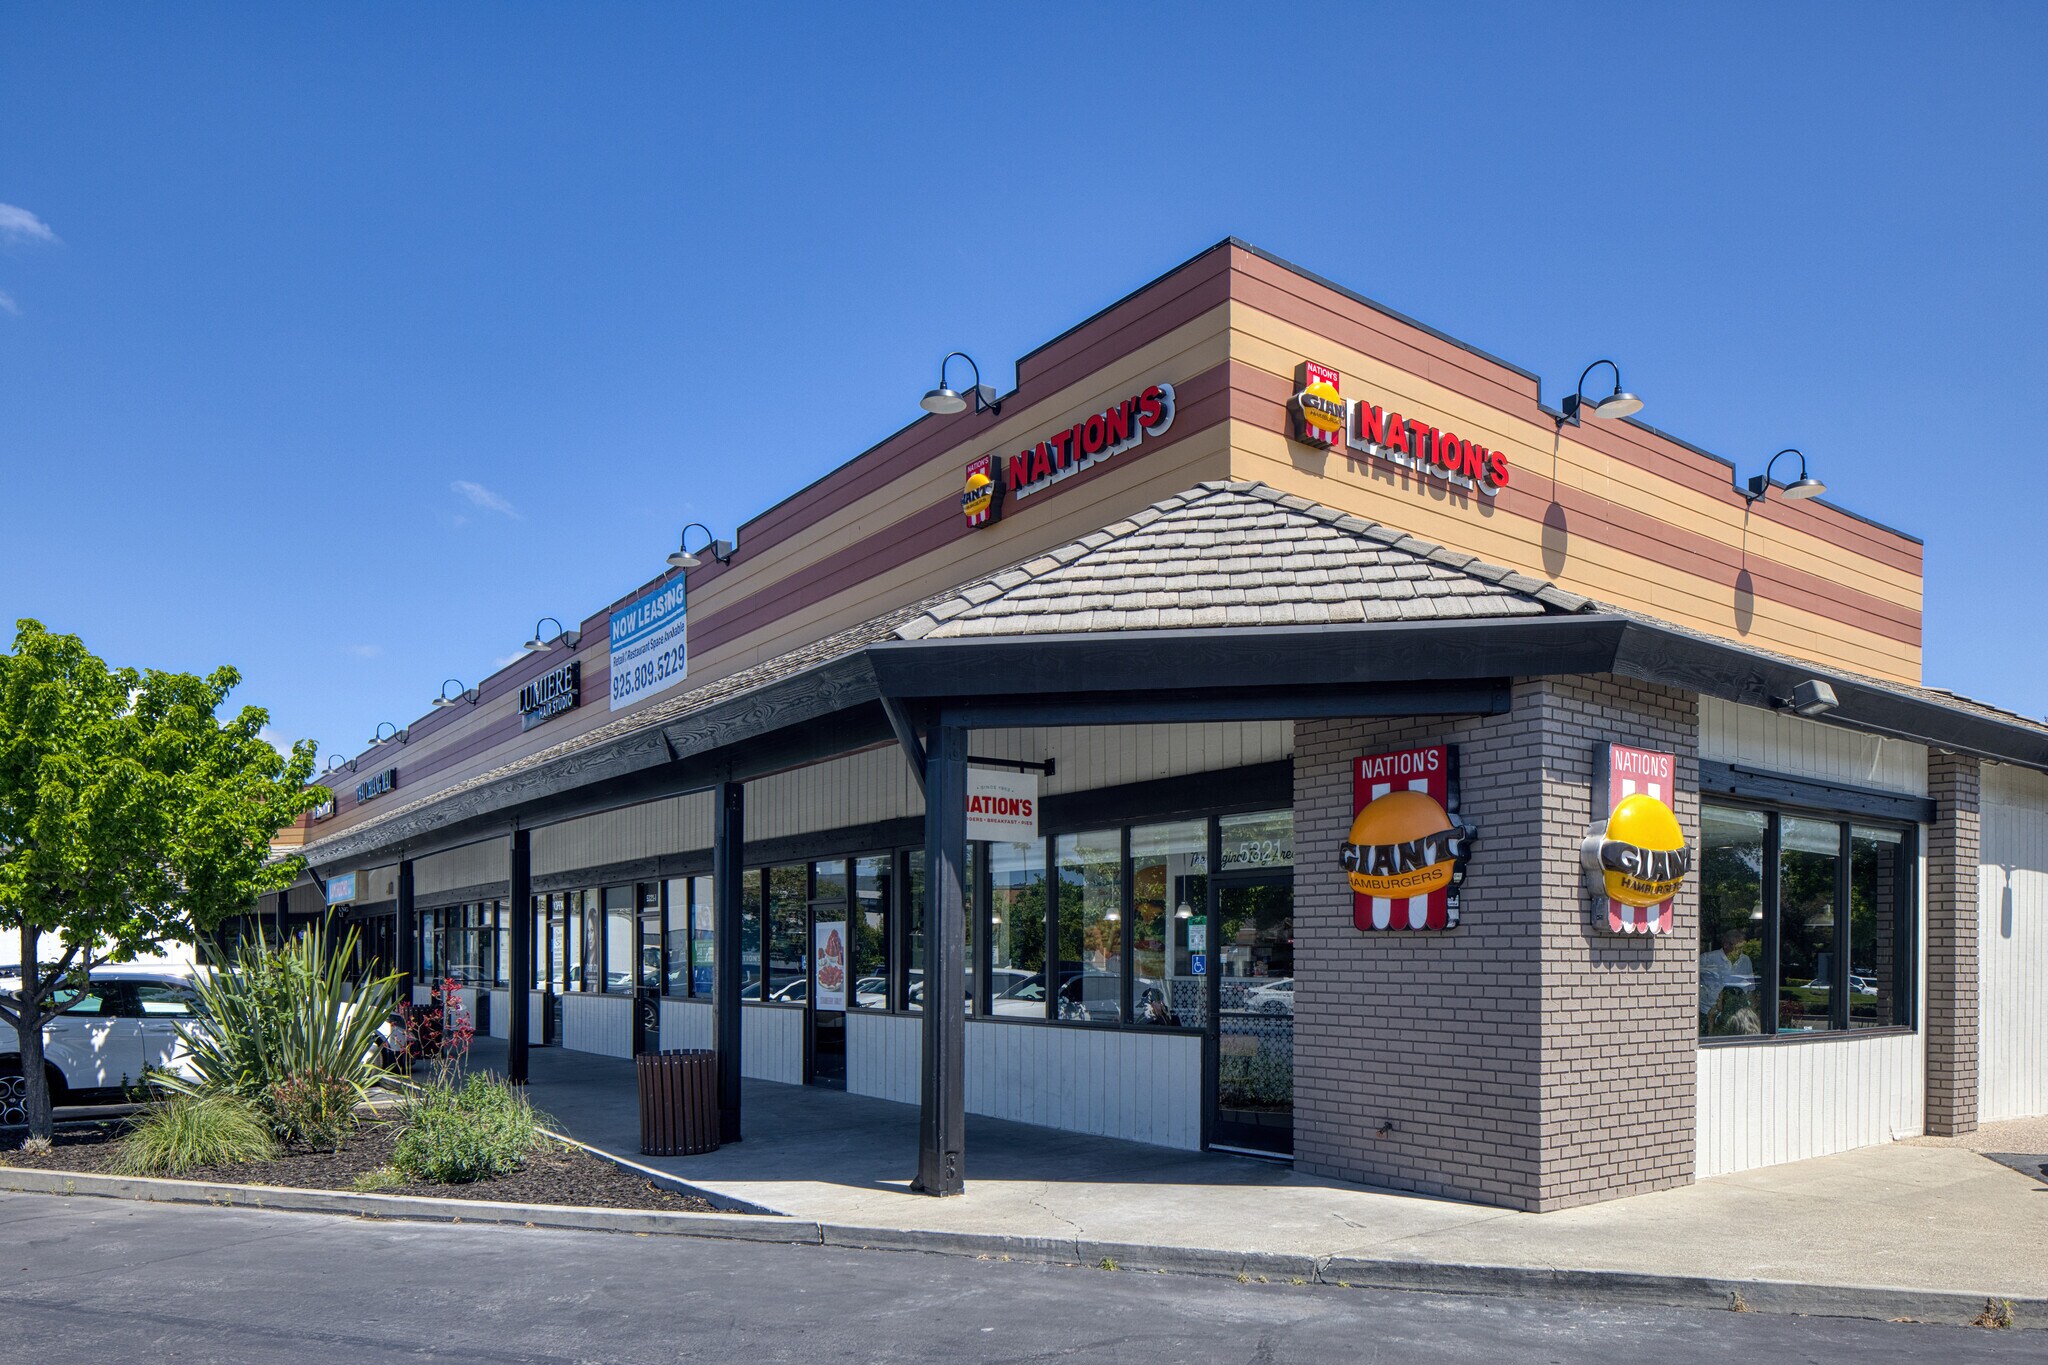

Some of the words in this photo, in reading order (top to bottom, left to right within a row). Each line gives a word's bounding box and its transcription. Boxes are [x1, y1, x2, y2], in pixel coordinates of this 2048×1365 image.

[1307, 363, 1338, 381] NATION'S
[1300, 393, 1344, 419] GIAN
[1009, 385, 1163, 491] NATION'S
[1360, 400, 1509, 488] NATION'S
[967, 456, 989, 473] NATION'S
[612, 611, 637, 641] NOW
[638, 583, 685, 626] LEASING
[613, 655, 625, 668] Retail
[627, 643, 650, 660] Restaurant
[650, 637, 663, 651] Space
[664, 622, 685, 644] Available
[612, 643, 685, 700] 925.809.5229
[518, 663, 573, 715] LUMIERE
[552, 693, 573, 714] STUDIO
[1362, 749, 1439, 780] NATION'S
[1615, 749, 1668, 778] NATION'S
[986, 817, 1018, 825] BREAKFAST
[1240, 839, 1281, 863] 5321
[1340, 825, 1465, 876] GIANT
